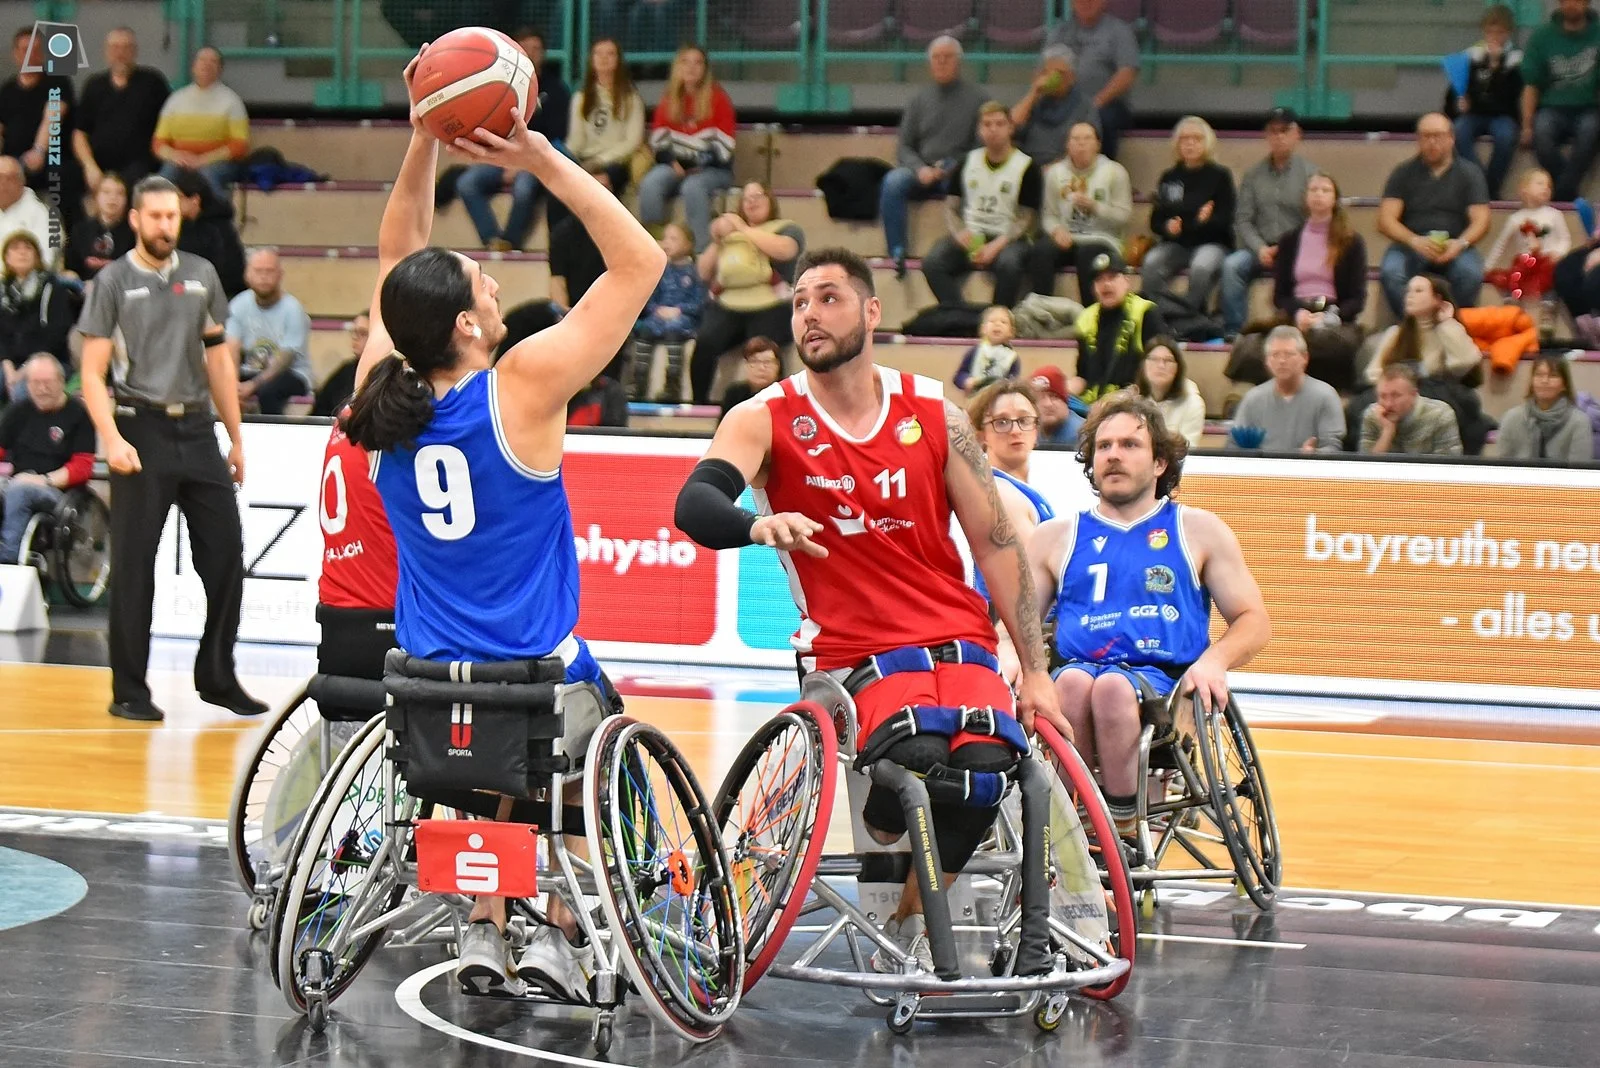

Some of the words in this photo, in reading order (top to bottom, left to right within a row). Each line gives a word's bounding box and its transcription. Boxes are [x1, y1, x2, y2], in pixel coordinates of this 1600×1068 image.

[414, 444, 476, 540] 9
[805, 475, 842, 490] Allianz
[874, 467, 907, 499] 11
[1305, 513, 1521, 574] bayreuths
[1129, 605, 1160, 617] GGZ
[1472, 591, 1575, 641] alles
[448, 748, 473, 757] SPORTA
